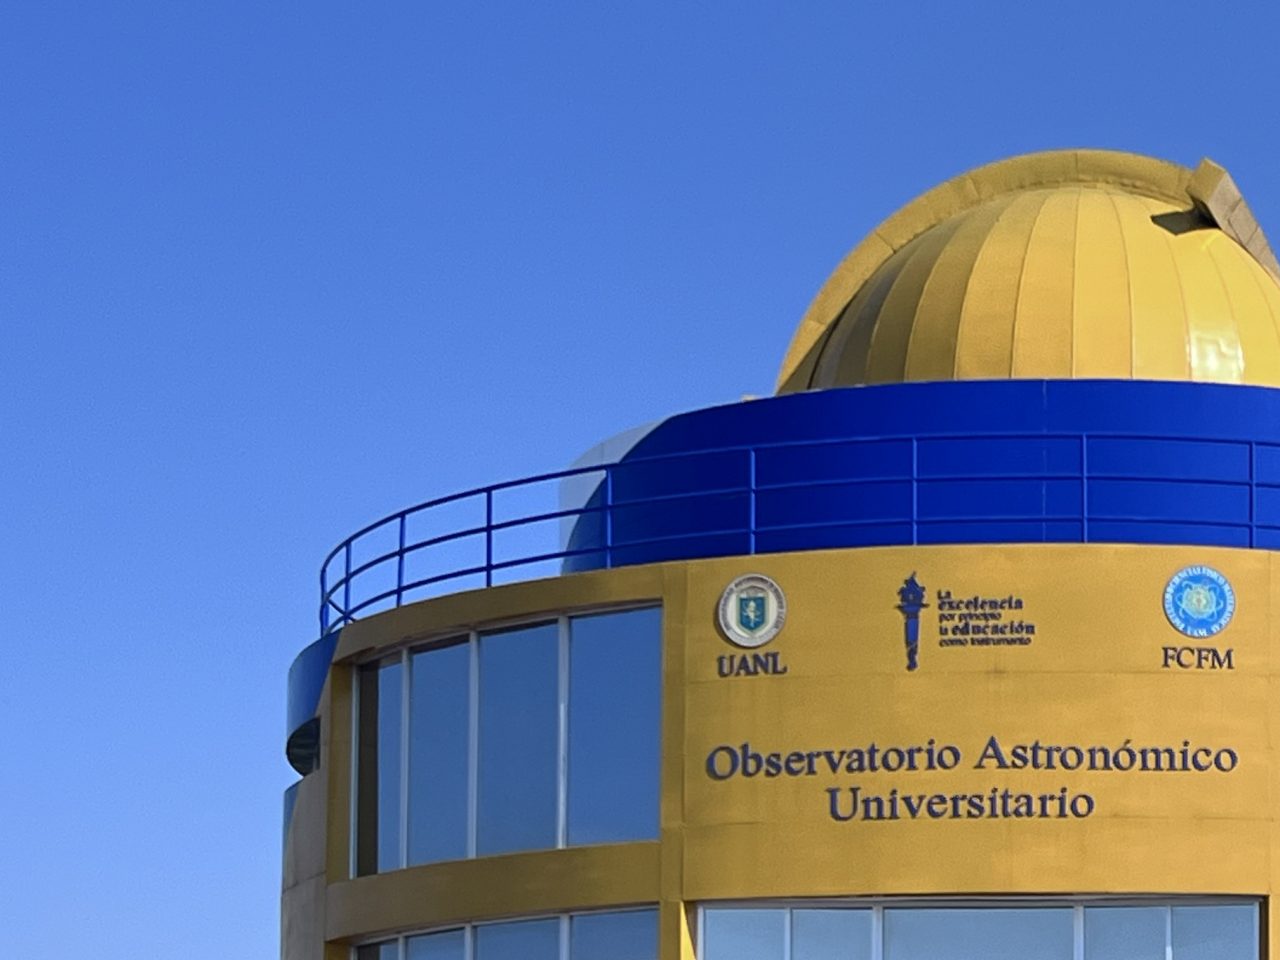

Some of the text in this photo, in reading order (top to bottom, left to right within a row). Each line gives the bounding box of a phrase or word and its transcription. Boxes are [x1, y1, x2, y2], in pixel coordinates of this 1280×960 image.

[937, 596, 1024, 611] excelencia
[939, 613, 958, 624] por
[951, 620, 1036, 636] educación
[939, 637, 969, 647] como
[716, 651, 788, 678] UANL
[1161, 646, 1235, 670] FCFM
[705, 735, 1239, 781] Observatorio Astronómico
[825, 786, 1095, 822] Universitario
